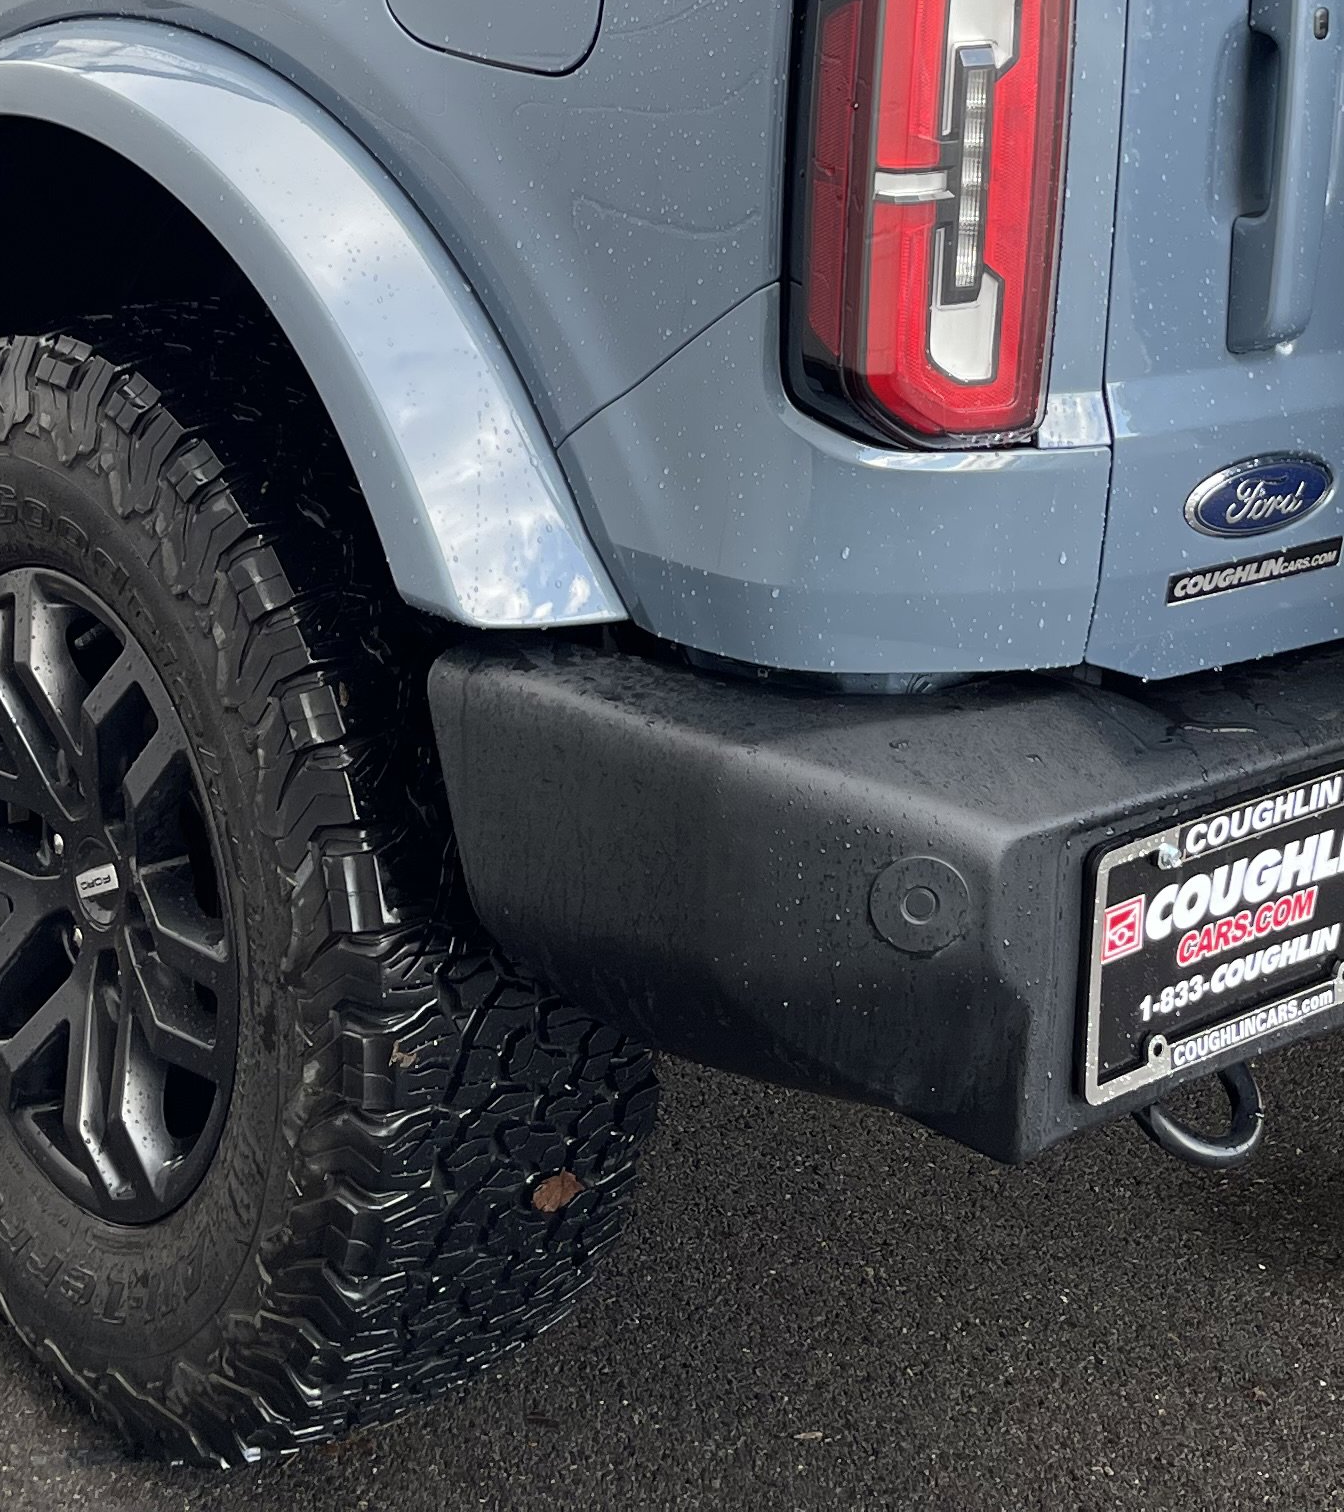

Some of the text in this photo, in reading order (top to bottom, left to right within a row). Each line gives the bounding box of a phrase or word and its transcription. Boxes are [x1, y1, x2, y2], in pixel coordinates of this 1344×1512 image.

[1225, 473, 1306, 525] Ford
[1173, 549, 1338, 598] COUGHLINCARS.COM
[1184, 775, 1344, 855] COUGHLIN
[1176, 885, 1319, 968] CARS.COM
[1138, 922, 1342, 1023] 1-833-COUGHLIN
[1172, 989, 1334, 1067] COUGHLINCARS.com
